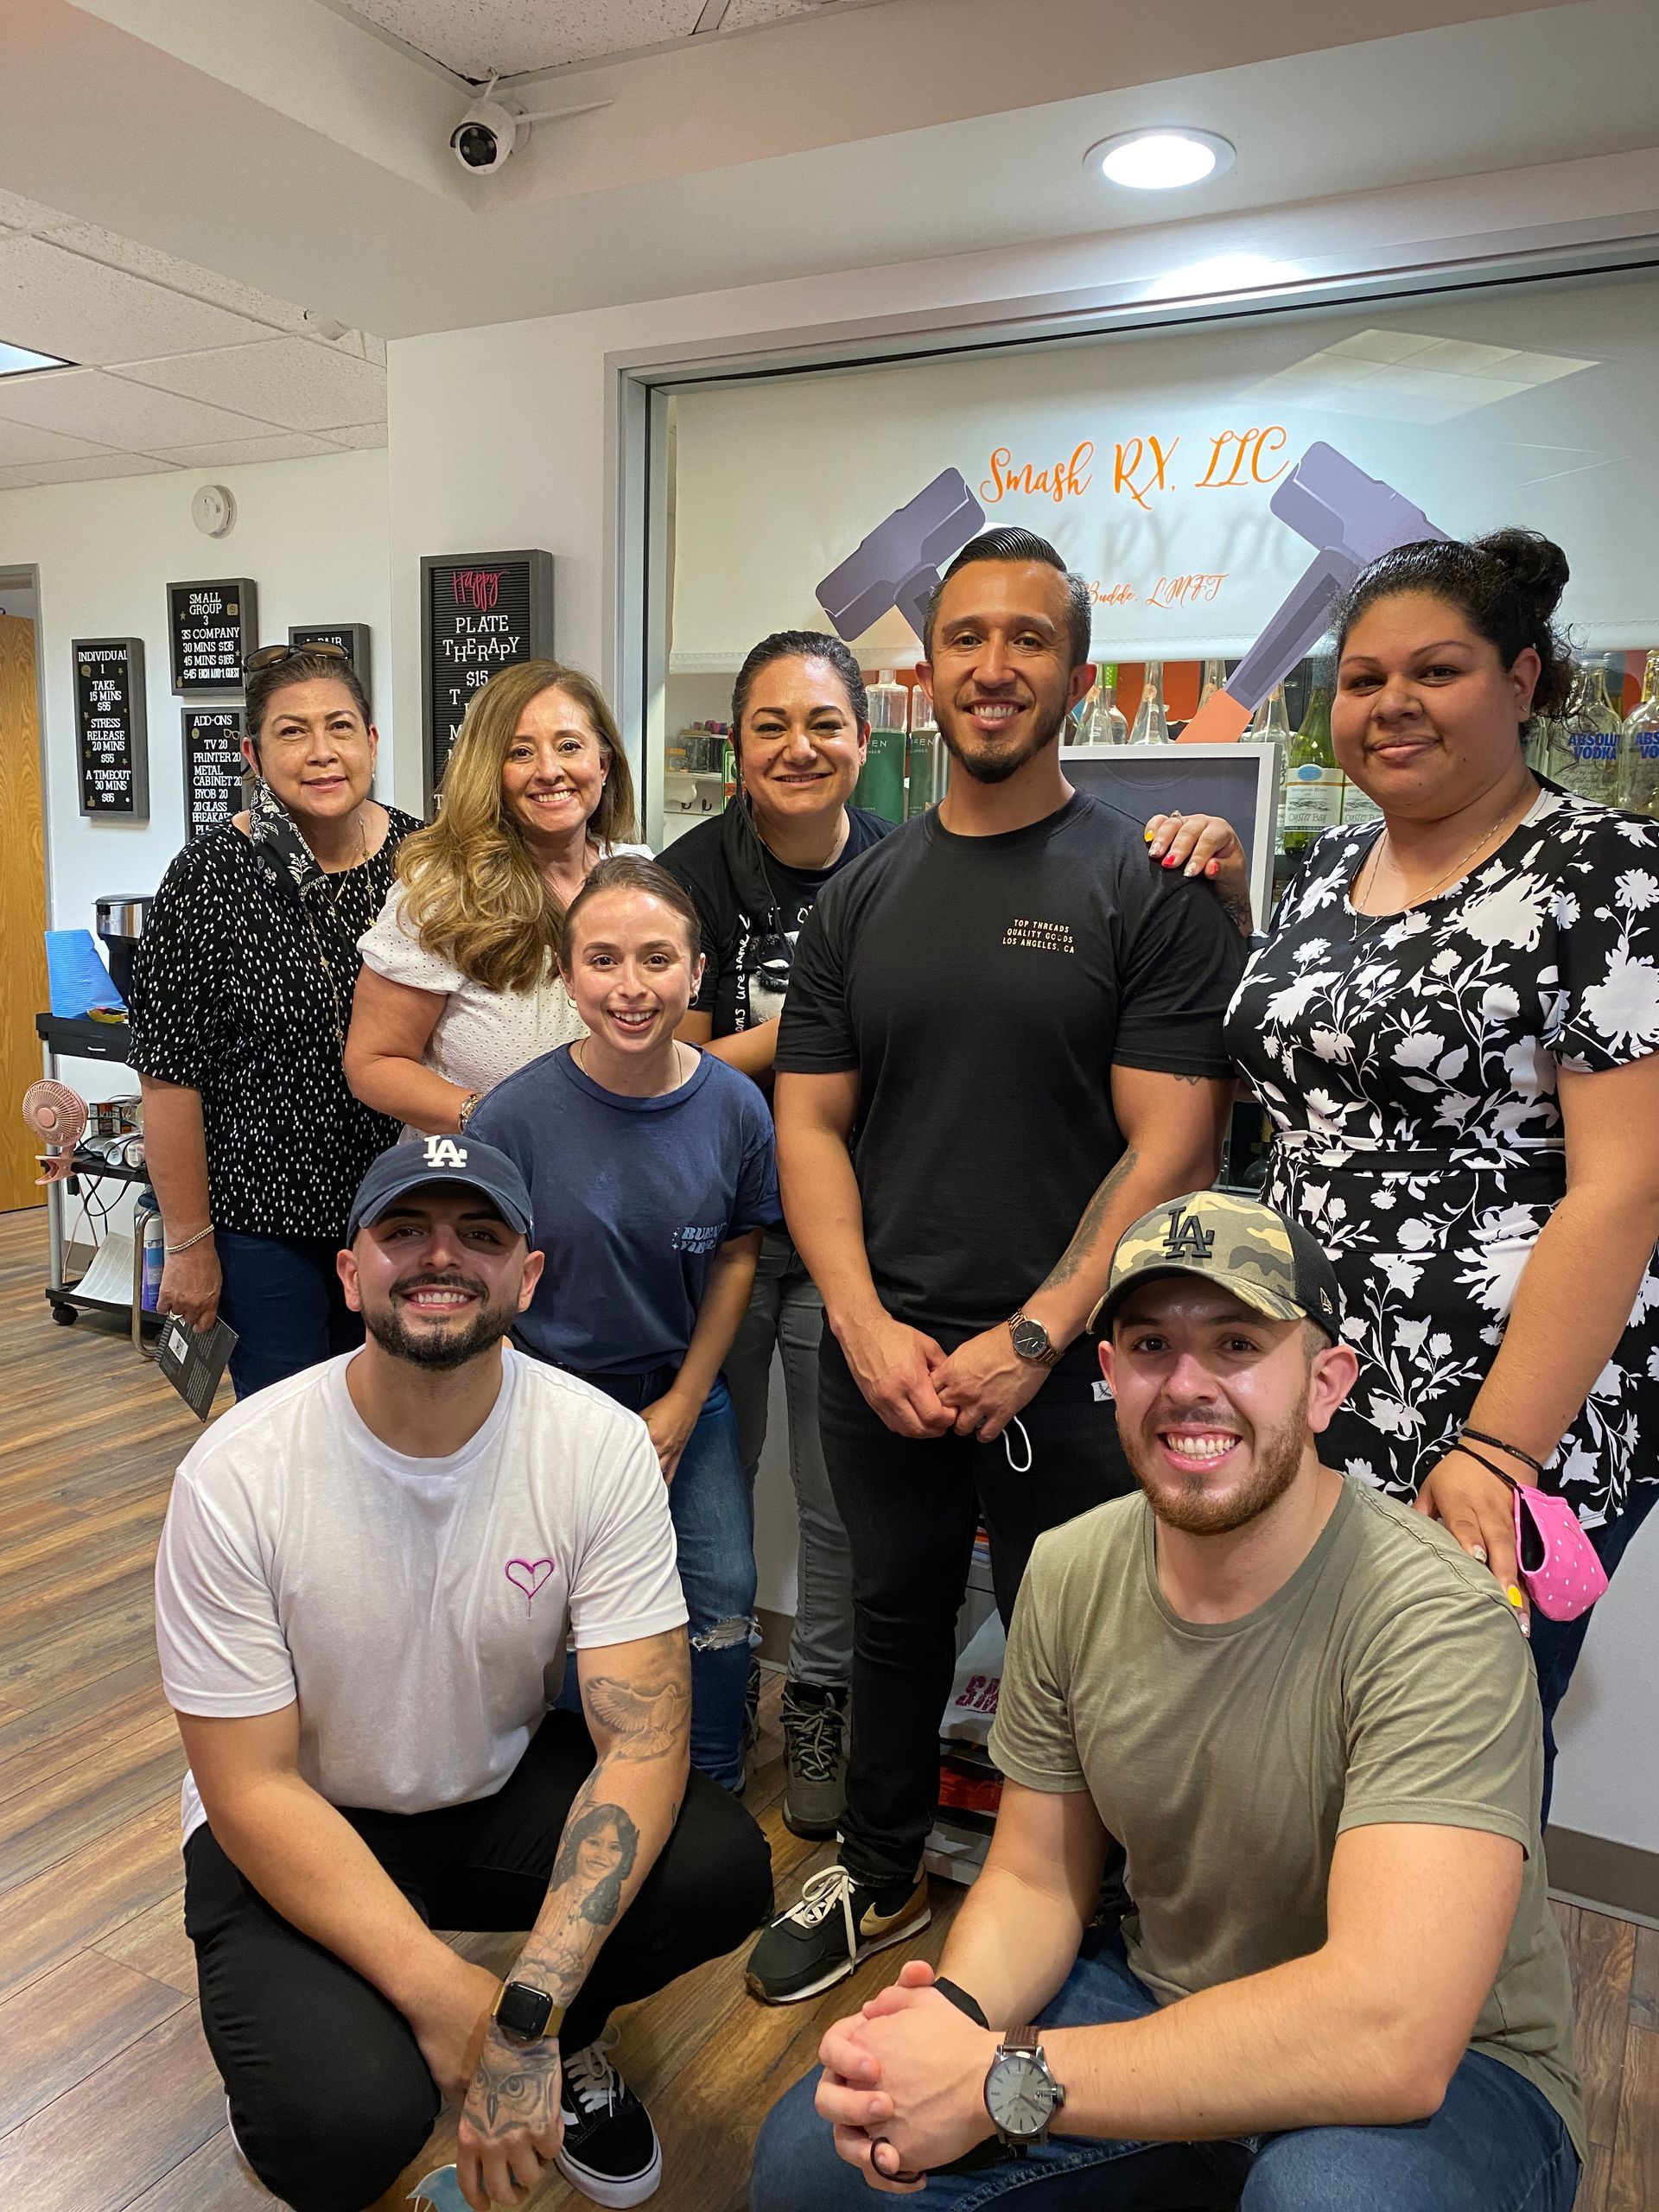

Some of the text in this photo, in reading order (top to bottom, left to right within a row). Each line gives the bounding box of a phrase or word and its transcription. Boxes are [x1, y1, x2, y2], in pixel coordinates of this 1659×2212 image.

[980, 442, 1094, 503] Smash
[1194, 426, 1289, 487] LLC
[452, 571, 511, 612] Happy
[189, 593, 221, 604] SMALL
[189, 603, 222, 615] GROUP
[204, 615, 208, 626] 3
[455, 615, 508, 633] PLATE
[193, 627, 240, 639] COMPANY
[183, 643, 192, 653] 30
[194, 641, 216, 652] MINS
[442, 636, 520, 662] THERAPY
[79, 650, 128, 662] INDIVIDUAL
[183, 656, 192, 665] 45
[194, 655, 216, 665] MINS
[100, 664, 105, 674] 1
[226, 667, 240, 677] GUEST
[467, 671, 488, 687] $15
[92, 681, 115, 690] TAKE
[90, 691, 121, 702] 15 MINS
[98, 702, 111, 711] $55
[91, 719, 121, 728] STRESS
[194, 715, 232, 726] ADD-ONS
[87, 731, 124, 741] RELEASE
[92, 741, 124, 751] 20 MINS
[204, 740, 228, 750] TV 20
[101, 753, 114, 764] $55
[194, 752, 240, 762] PRINTER 20
[1573, 747, 1616, 760] VODKA
[86, 770, 131, 779] A TIMEOUT
[194, 766, 223, 776] METAL
[95, 781, 128, 790] 30 MINS
[194, 776, 242, 786] CABINET 20
[194, 789, 228, 798] BYOB 20
[202, 802, 228, 812] GLASS
[1033, 921, 1070, 933] THREADS
[1007, 928, 1073, 944] QUALITY GOODS
[1002, 937, 1017, 945] LOS
[1065, 945, 1075, 954] CA
[423, 1135, 467, 1168] LA
[1163, 1206, 1215, 1260] LA
